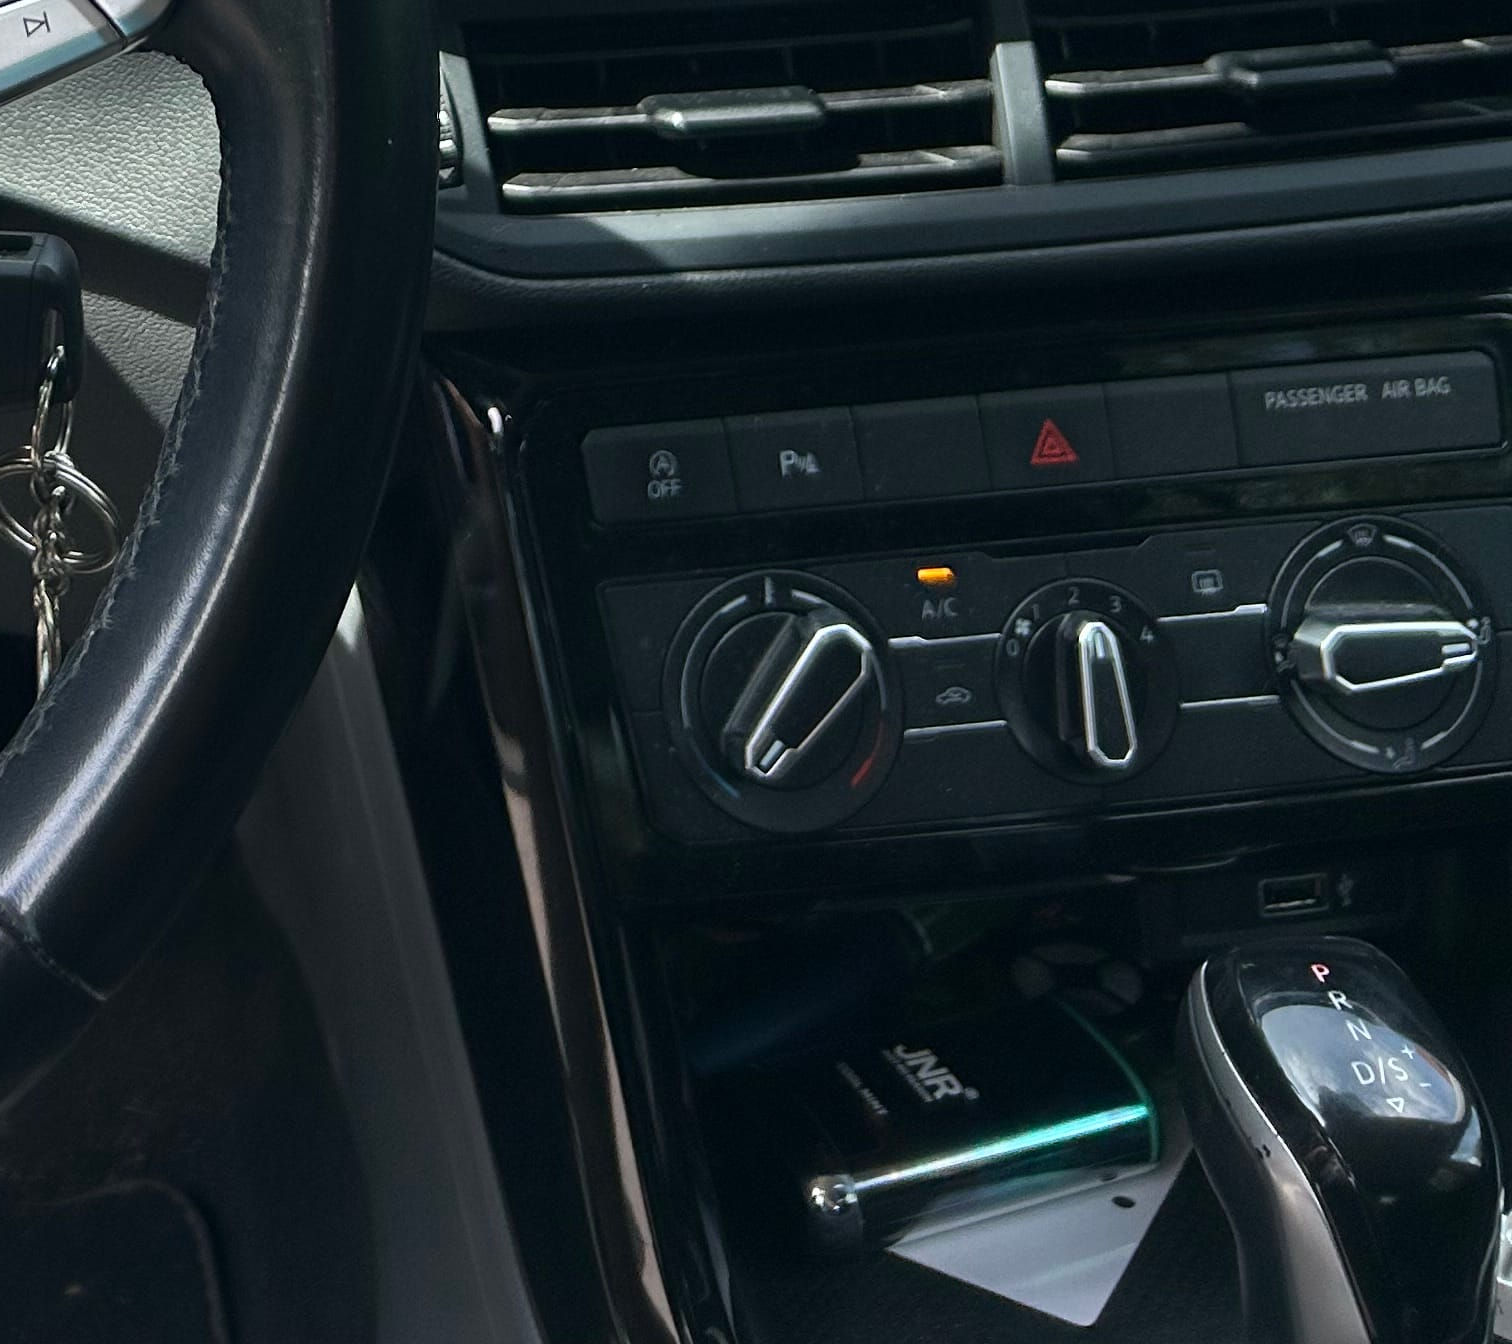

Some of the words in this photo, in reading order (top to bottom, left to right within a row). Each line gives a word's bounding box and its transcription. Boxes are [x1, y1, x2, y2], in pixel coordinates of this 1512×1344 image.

[1264, 383, 1368, 411] PASSENGER
[1380, 379, 1412, 400] AIR
[1414, 376, 1452, 397] BAG
[647, 478, 682, 499] OFF
[1068, 586, 1081, 605] 2
[1109, 595, 1122, 613] 3
[921, 597, 958, 621] A/C
[1032, 603, 1041, 620] 1
[1139, 625, 1155, 643] 4
[1006, 638, 1020, 657] 0
[1310, 963, 1330, 983] P
[1328, 990, 1353, 1010] R
[1345, 1018, 1373, 1041] N
[1351, 1056, 1408, 1085] D/S
